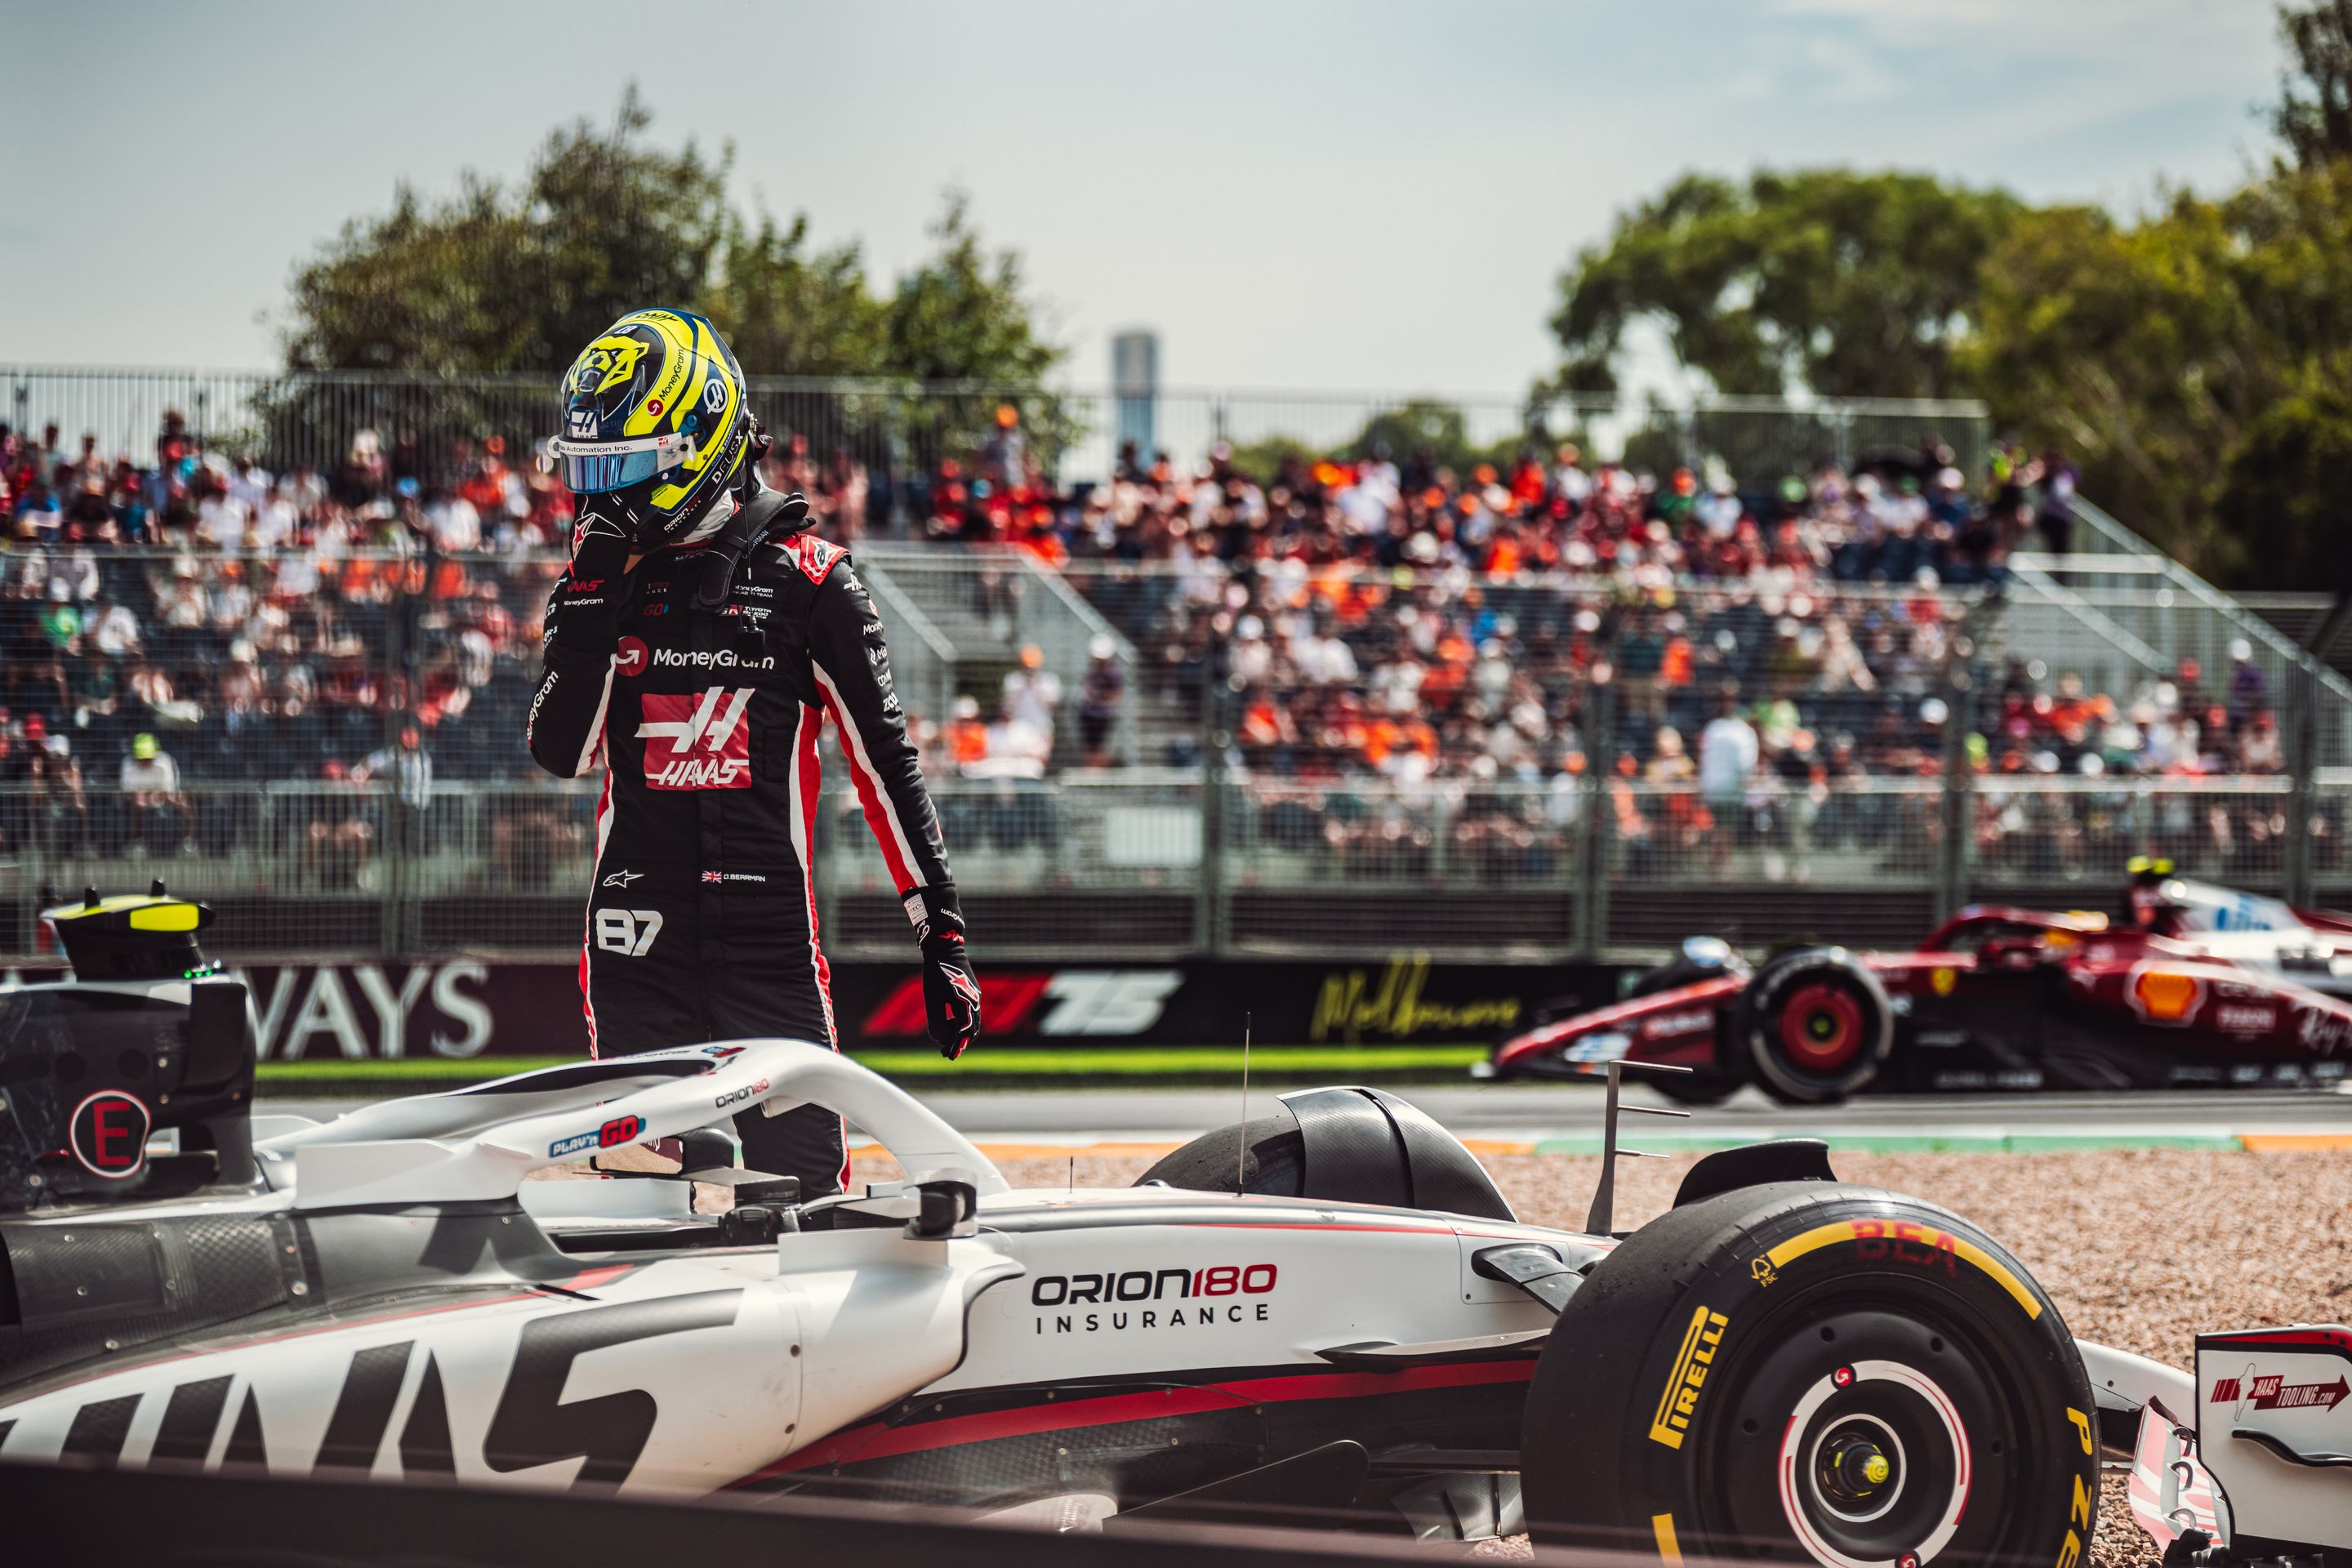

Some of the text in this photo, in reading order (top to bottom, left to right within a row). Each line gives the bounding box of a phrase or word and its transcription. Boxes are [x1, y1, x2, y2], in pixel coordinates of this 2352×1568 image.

[660, 348, 684, 401] MoneyGram
[645, 759, 750, 786] HAAS
[595, 908, 663, 956] 87
[715, 1078, 769, 1109] ORION180
[93, 1101, 131, 1166] E
[602, 1116, 639, 1147] GO
[1851, 1218, 1957, 1277] BEA
[1031, 1264, 1277, 1307] ORION180
[1760, 1273, 1779, 1288] FSC
[1036, 1303, 1268, 1334] INSURANCE
[1649, 1306, 1729, 1450] PIRELLI
[2253, 1378, 2278, 1396] HAAS
[2066, 1406, 2092, 1455] P
